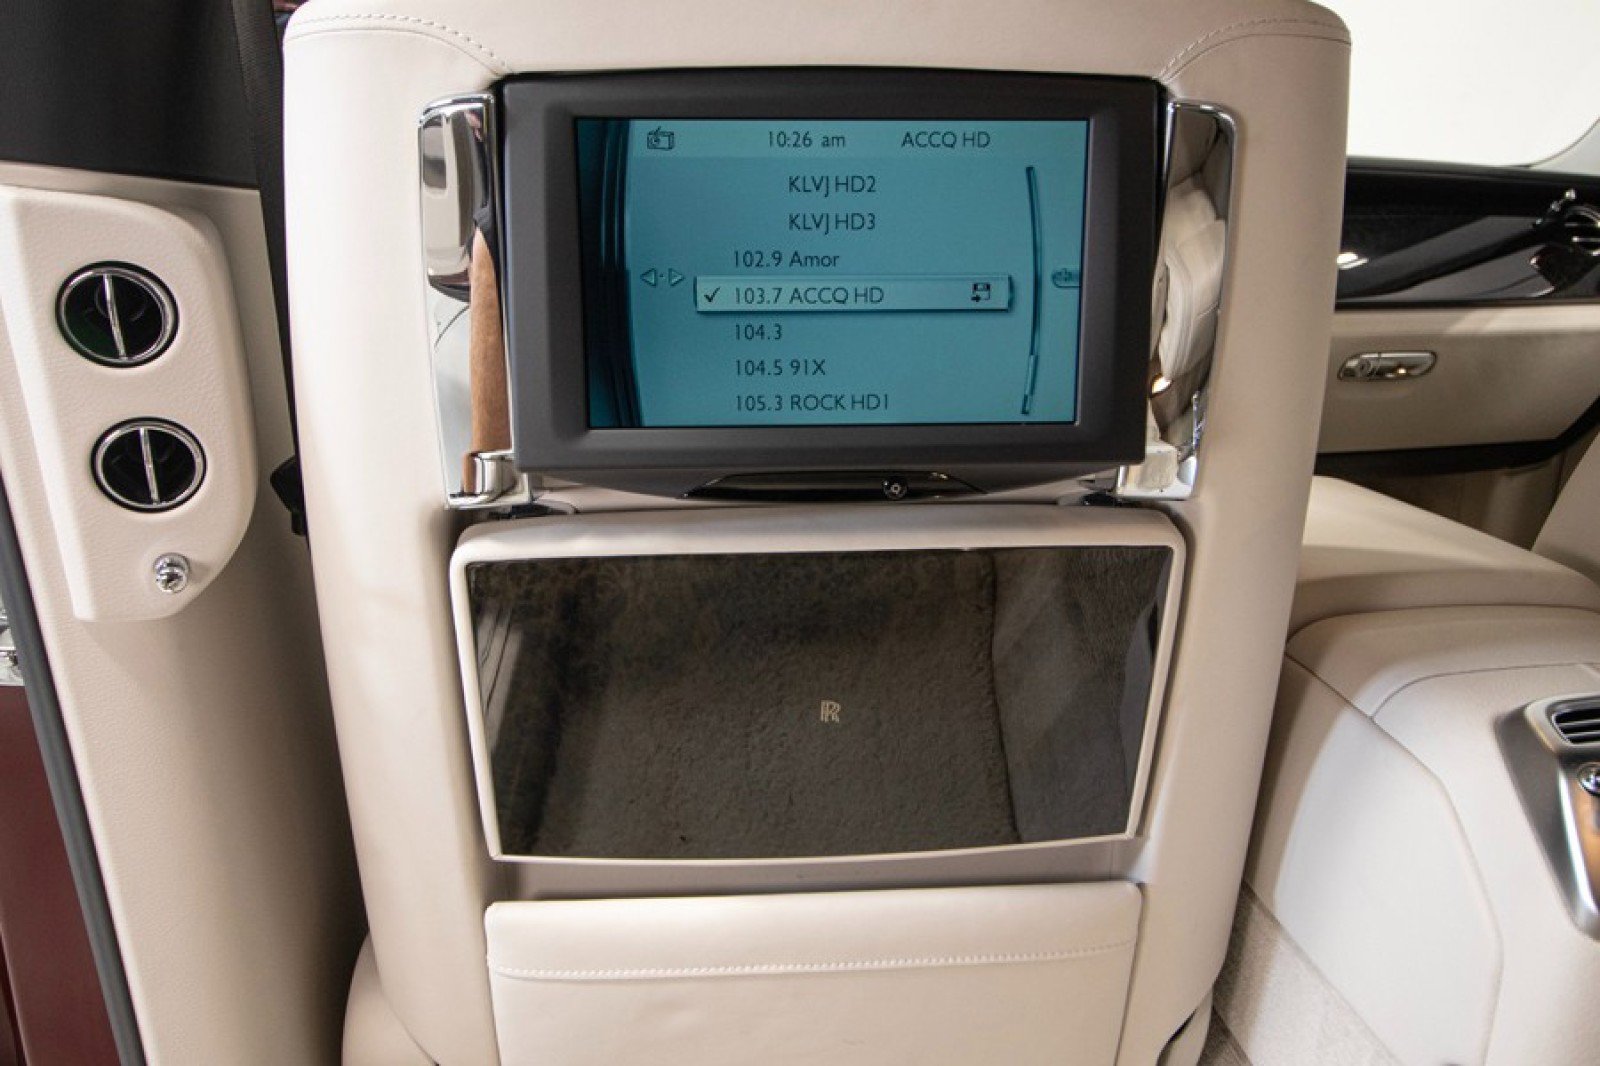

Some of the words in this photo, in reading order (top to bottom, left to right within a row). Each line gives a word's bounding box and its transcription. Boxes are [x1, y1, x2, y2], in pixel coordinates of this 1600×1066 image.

[767, 131, 813, 149] 10:26
[821, 134, 846, 148] am
[901, 130, 958, 150] ACCQ
[962, 130, 991, 148] HD
[788, 175, 830, 198] KLVJ
[834, 175, 877, 194] HD2
[788, 213, 830, 235] KLVJ
[834, 213, 876, 231] HD3
[733, 250, 783, 268] 102.9
[788, 250, 840, 269] Amor
[734, 286, 782, 304] 103.7
[788, 286, 849, 306] ACCQ
[854, 287, 885, 304] HD
[735, 323, 783, 341] 104.3
[735, 359, 783, 377] 104.5
[790, 358, 826, 376] 91X
[735, 394, 784, 412] 105.3
[790, 394, 846, 412] ROCK
[851, 393, 890, 411] HD1
